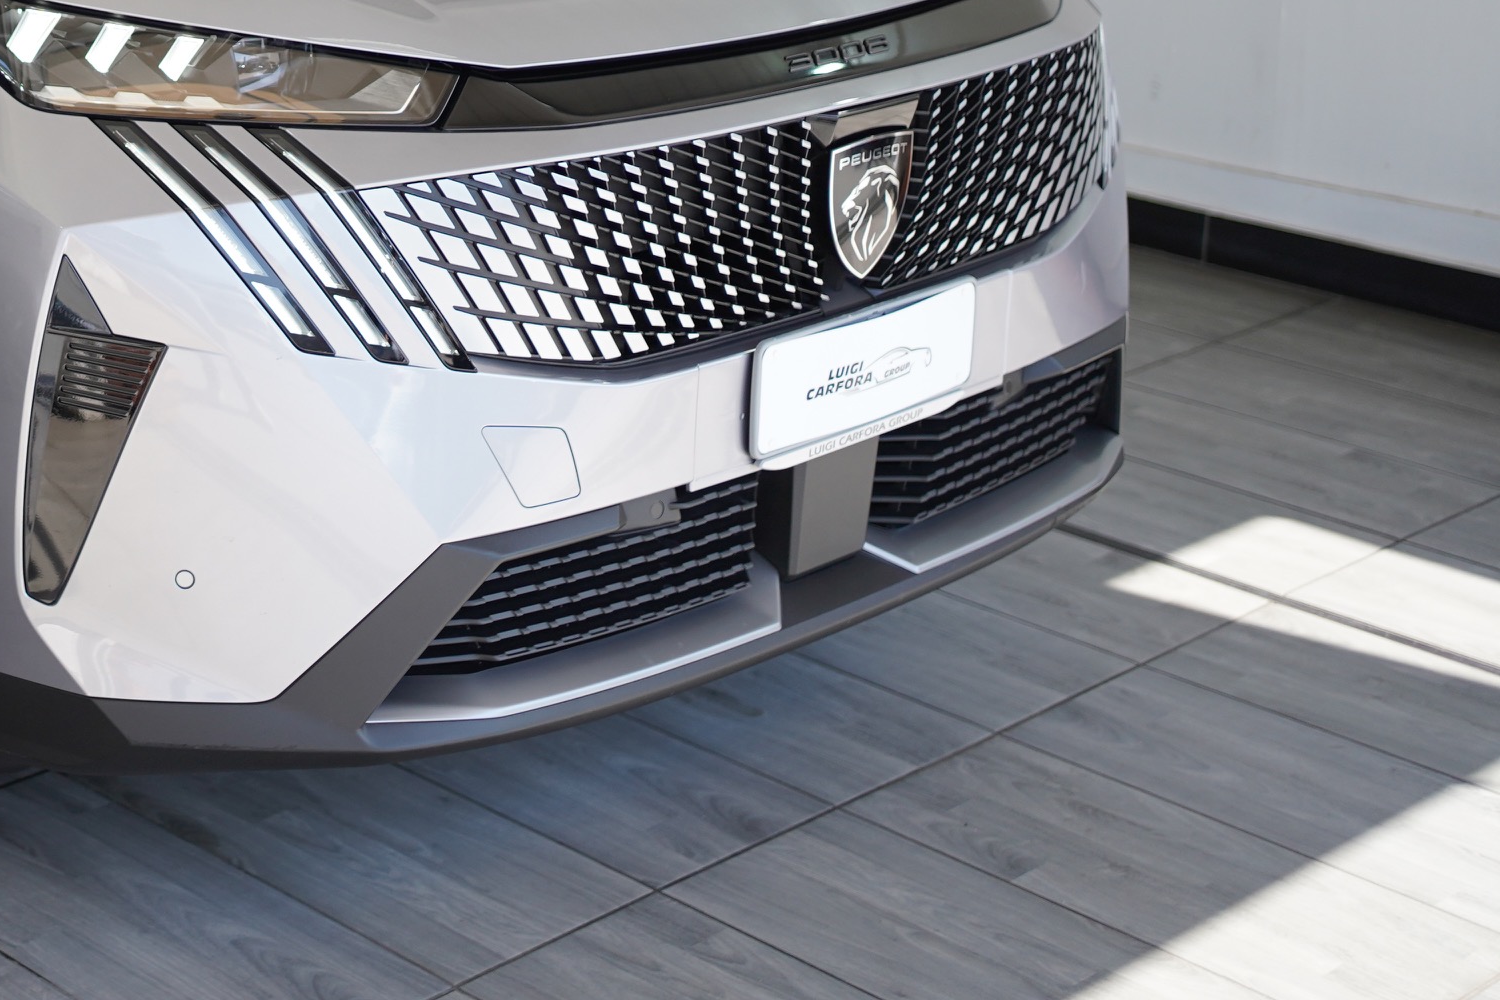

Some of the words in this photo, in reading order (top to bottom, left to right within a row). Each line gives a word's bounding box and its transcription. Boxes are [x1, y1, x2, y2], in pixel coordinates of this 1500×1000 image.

[839, 143, 907, 170] PEUGEOT
[828, 362, 863, 380] LUIGI
[884, 363, 910, 377] GROUP
[806, 372, 872, 400] CARFORA
[809, 442, 835, 457] LUIGI
[840, 423, 885, 444] CARFORA
[889, 409, 923, 428] GROUP
